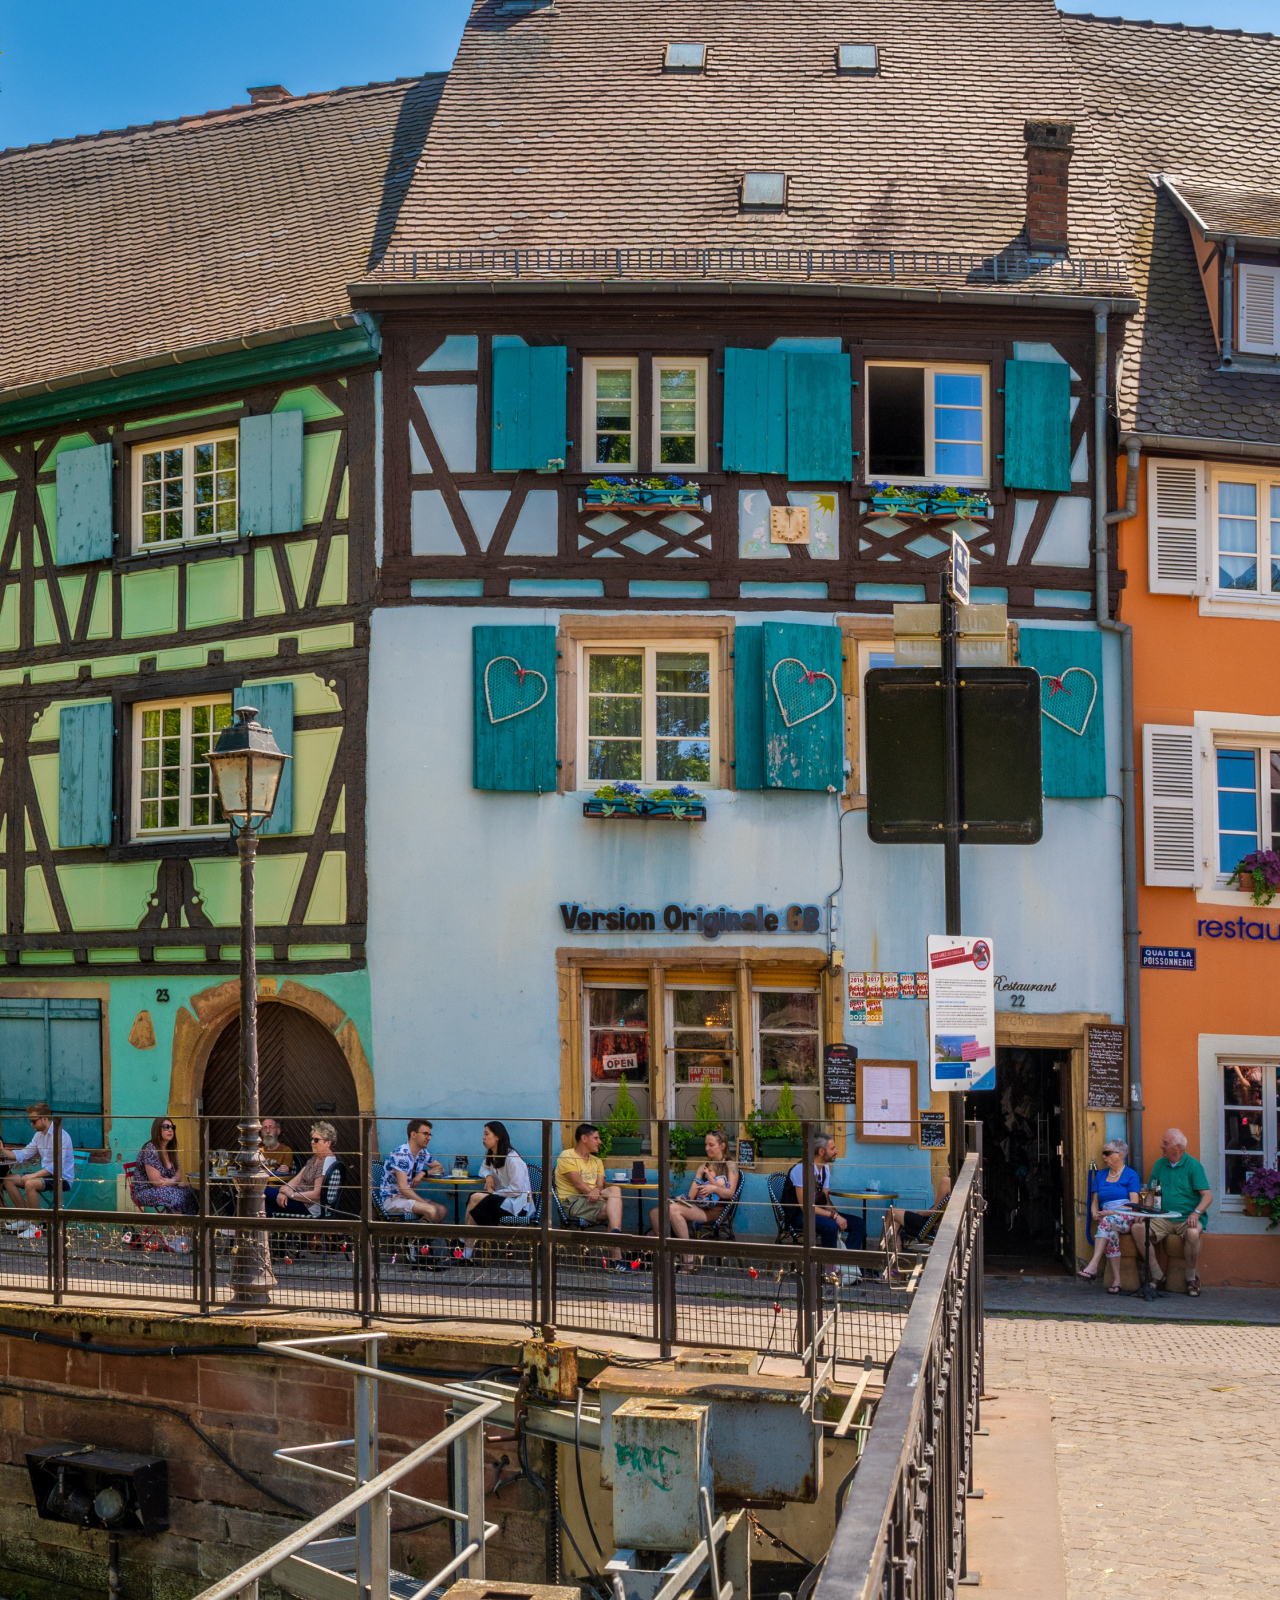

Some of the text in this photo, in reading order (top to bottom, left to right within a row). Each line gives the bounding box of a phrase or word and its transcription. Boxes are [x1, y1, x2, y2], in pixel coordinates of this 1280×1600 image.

[559, 904, 820, 938] Version Originale 68
[1145, 949, 1166, 957] QUAI
[1143, 957, 1194, 967] POISSONNERIE
[993, 975, 1057, 993] Restaurant
[156, 988, 170, 1002] 23
[1010, 994, 1026, 1008] 22
[606, 1058, 634, 1069] OPEN
